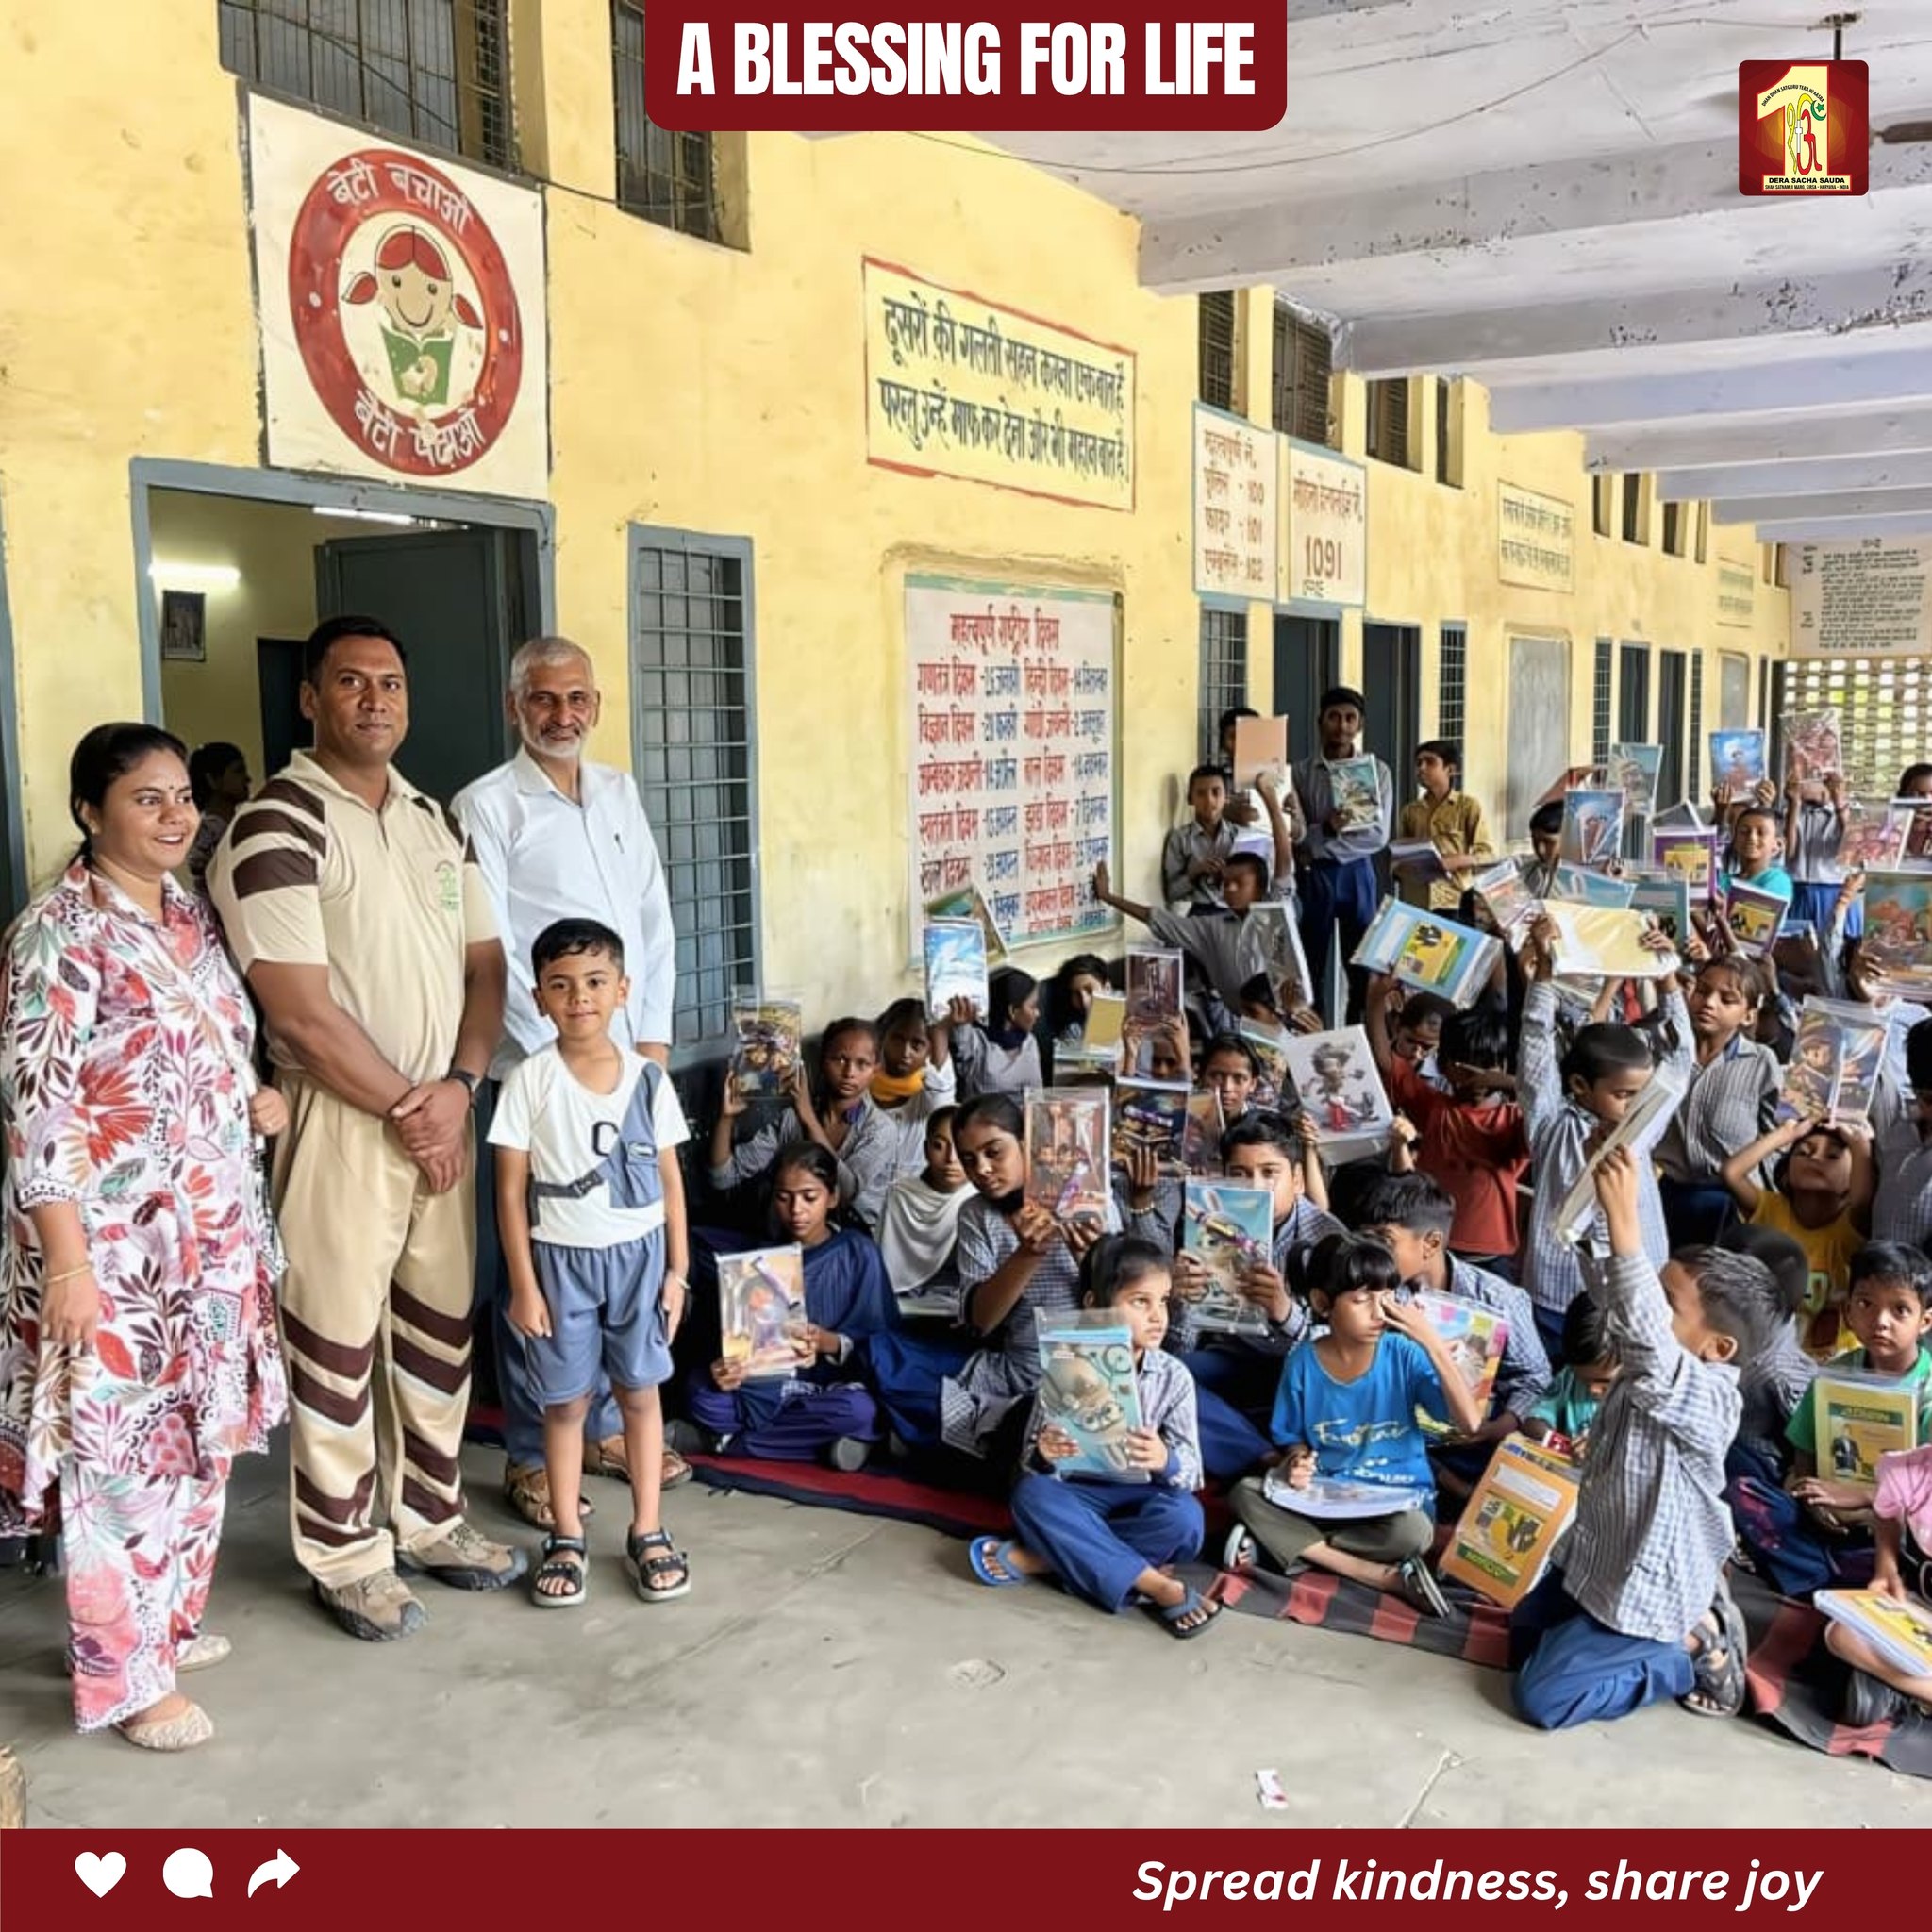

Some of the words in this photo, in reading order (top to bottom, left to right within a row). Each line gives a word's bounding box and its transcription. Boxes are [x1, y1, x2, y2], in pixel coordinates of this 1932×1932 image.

[327, 160, 380, 205] बेटी
[385, 161, 472, 235] बचाओ
[883, 291, 929, 366] दूसरों
[933, 299, 958, 364] की
[959, 315, 1002, 377] गलती
[1306, 534, 1341, 580] 1091
